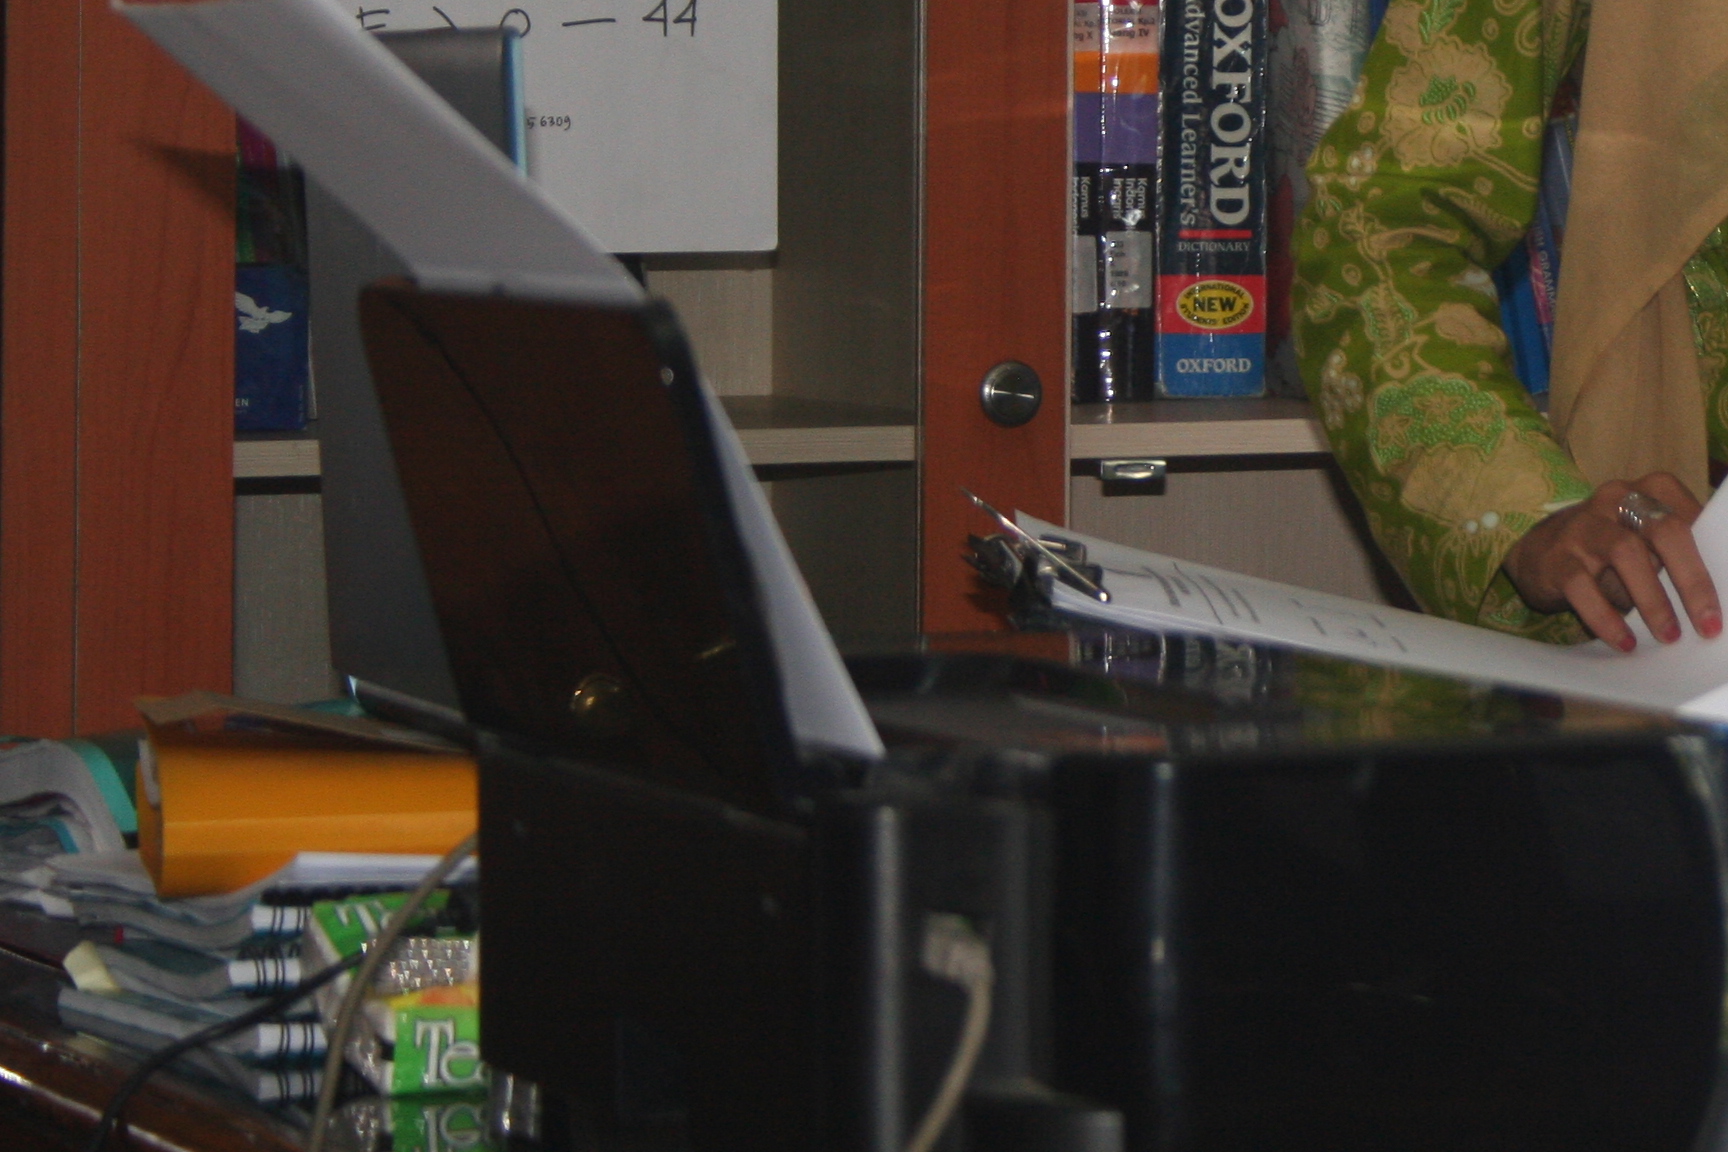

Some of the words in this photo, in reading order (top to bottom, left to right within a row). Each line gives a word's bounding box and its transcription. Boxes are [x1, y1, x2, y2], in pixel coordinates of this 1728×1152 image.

[1179, 113, 1201, 227] Learner's
[1080, 176, 1091, 219] Kamus
[1178, 241, 1251, 253] DICTIONARY
[1192, 296, 1237, 313] NEW
[1176, 357, 1252, 374] OXFORD
